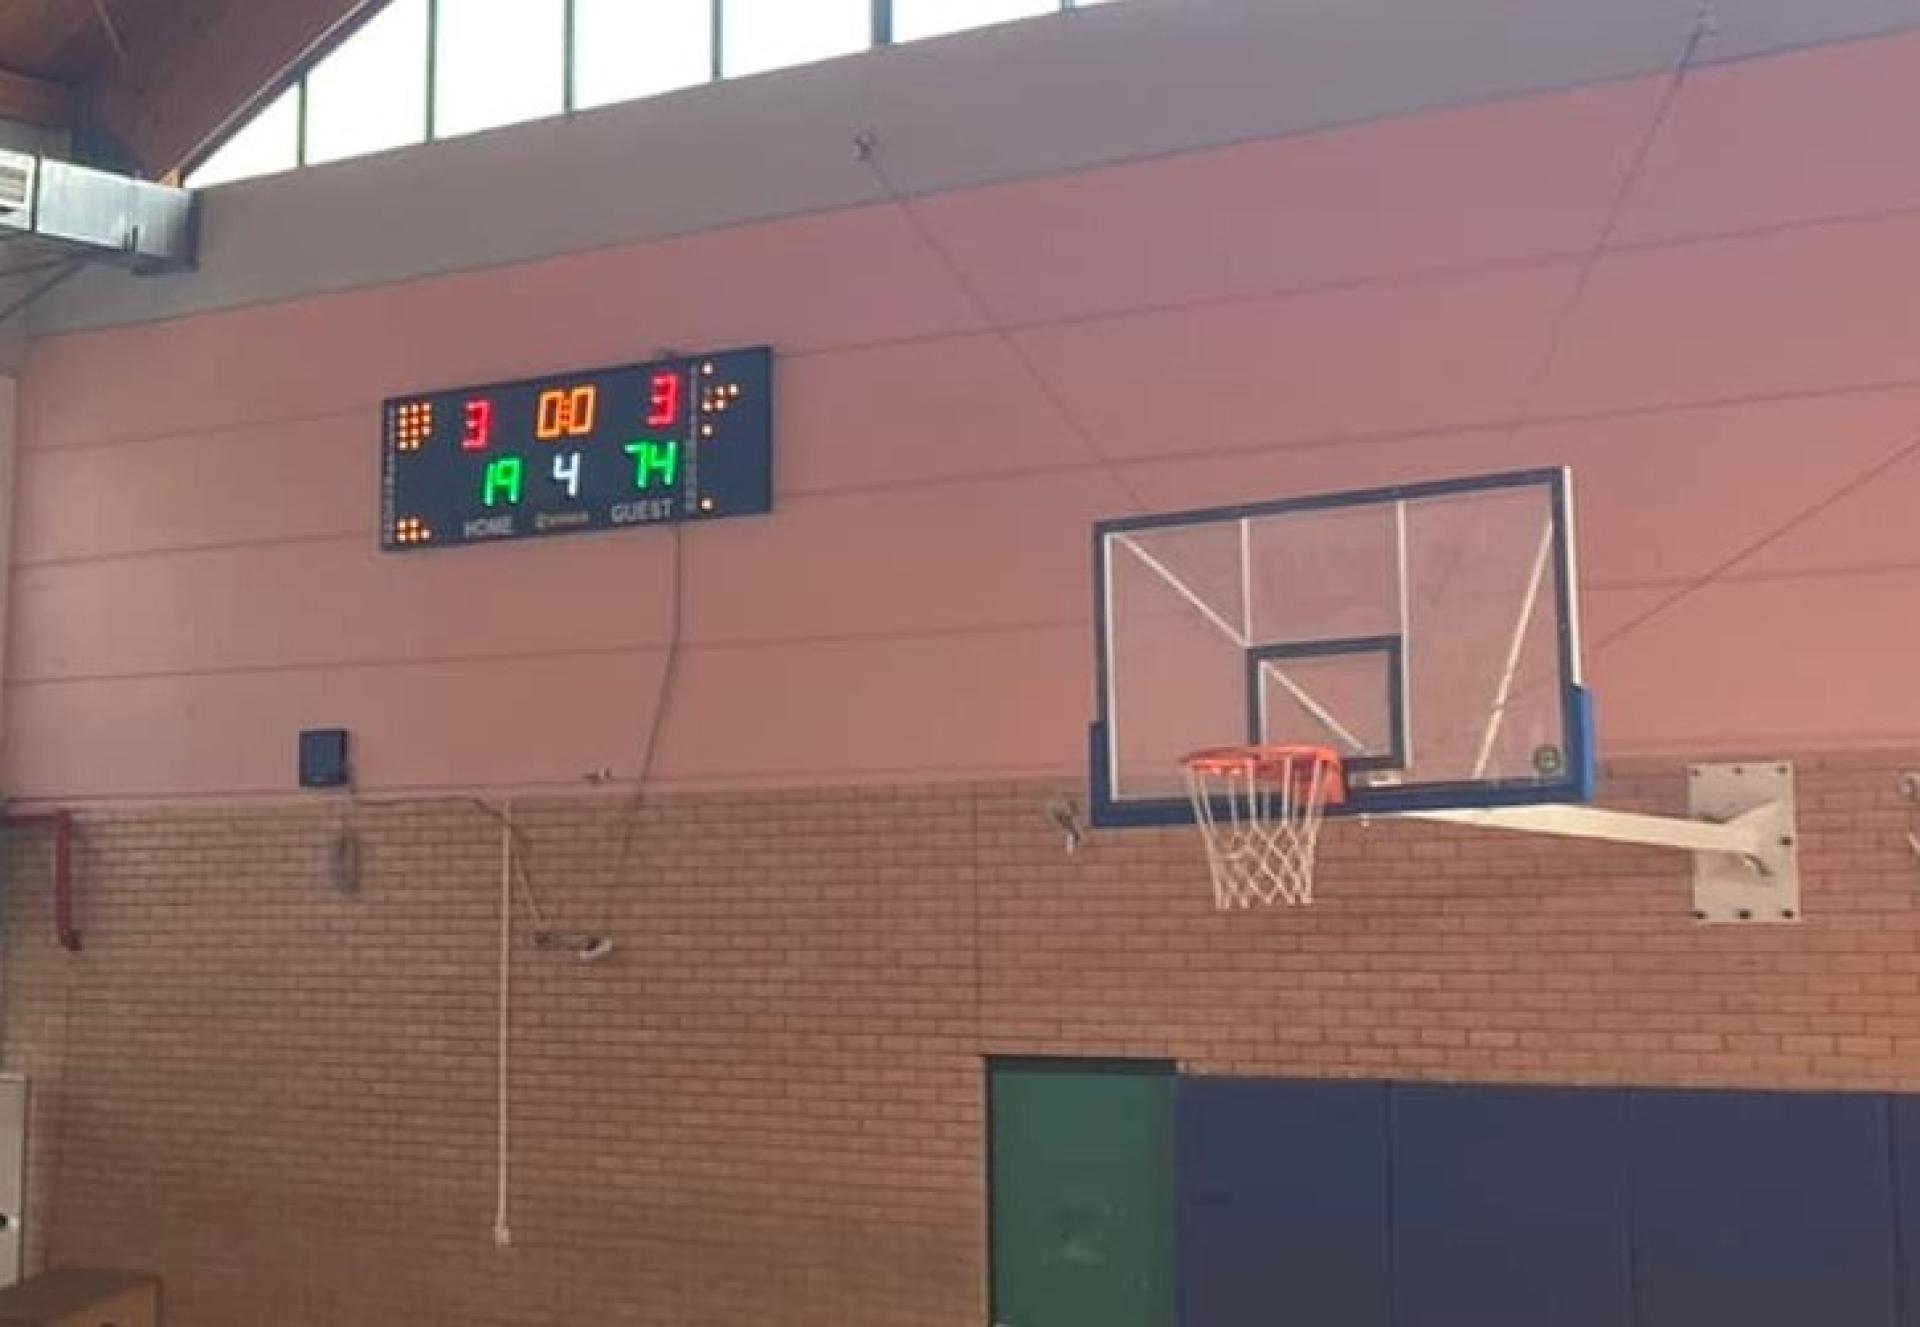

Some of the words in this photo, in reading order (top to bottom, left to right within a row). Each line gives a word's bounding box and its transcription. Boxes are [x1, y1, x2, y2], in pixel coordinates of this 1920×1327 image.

[646, 372, 680, 425] 3
[462, 399, 491, 449] 3
[553, 452, 581, 497] 4
[624, 441, 678, 489] 74
[611, 497, 675, 523] GUEST
